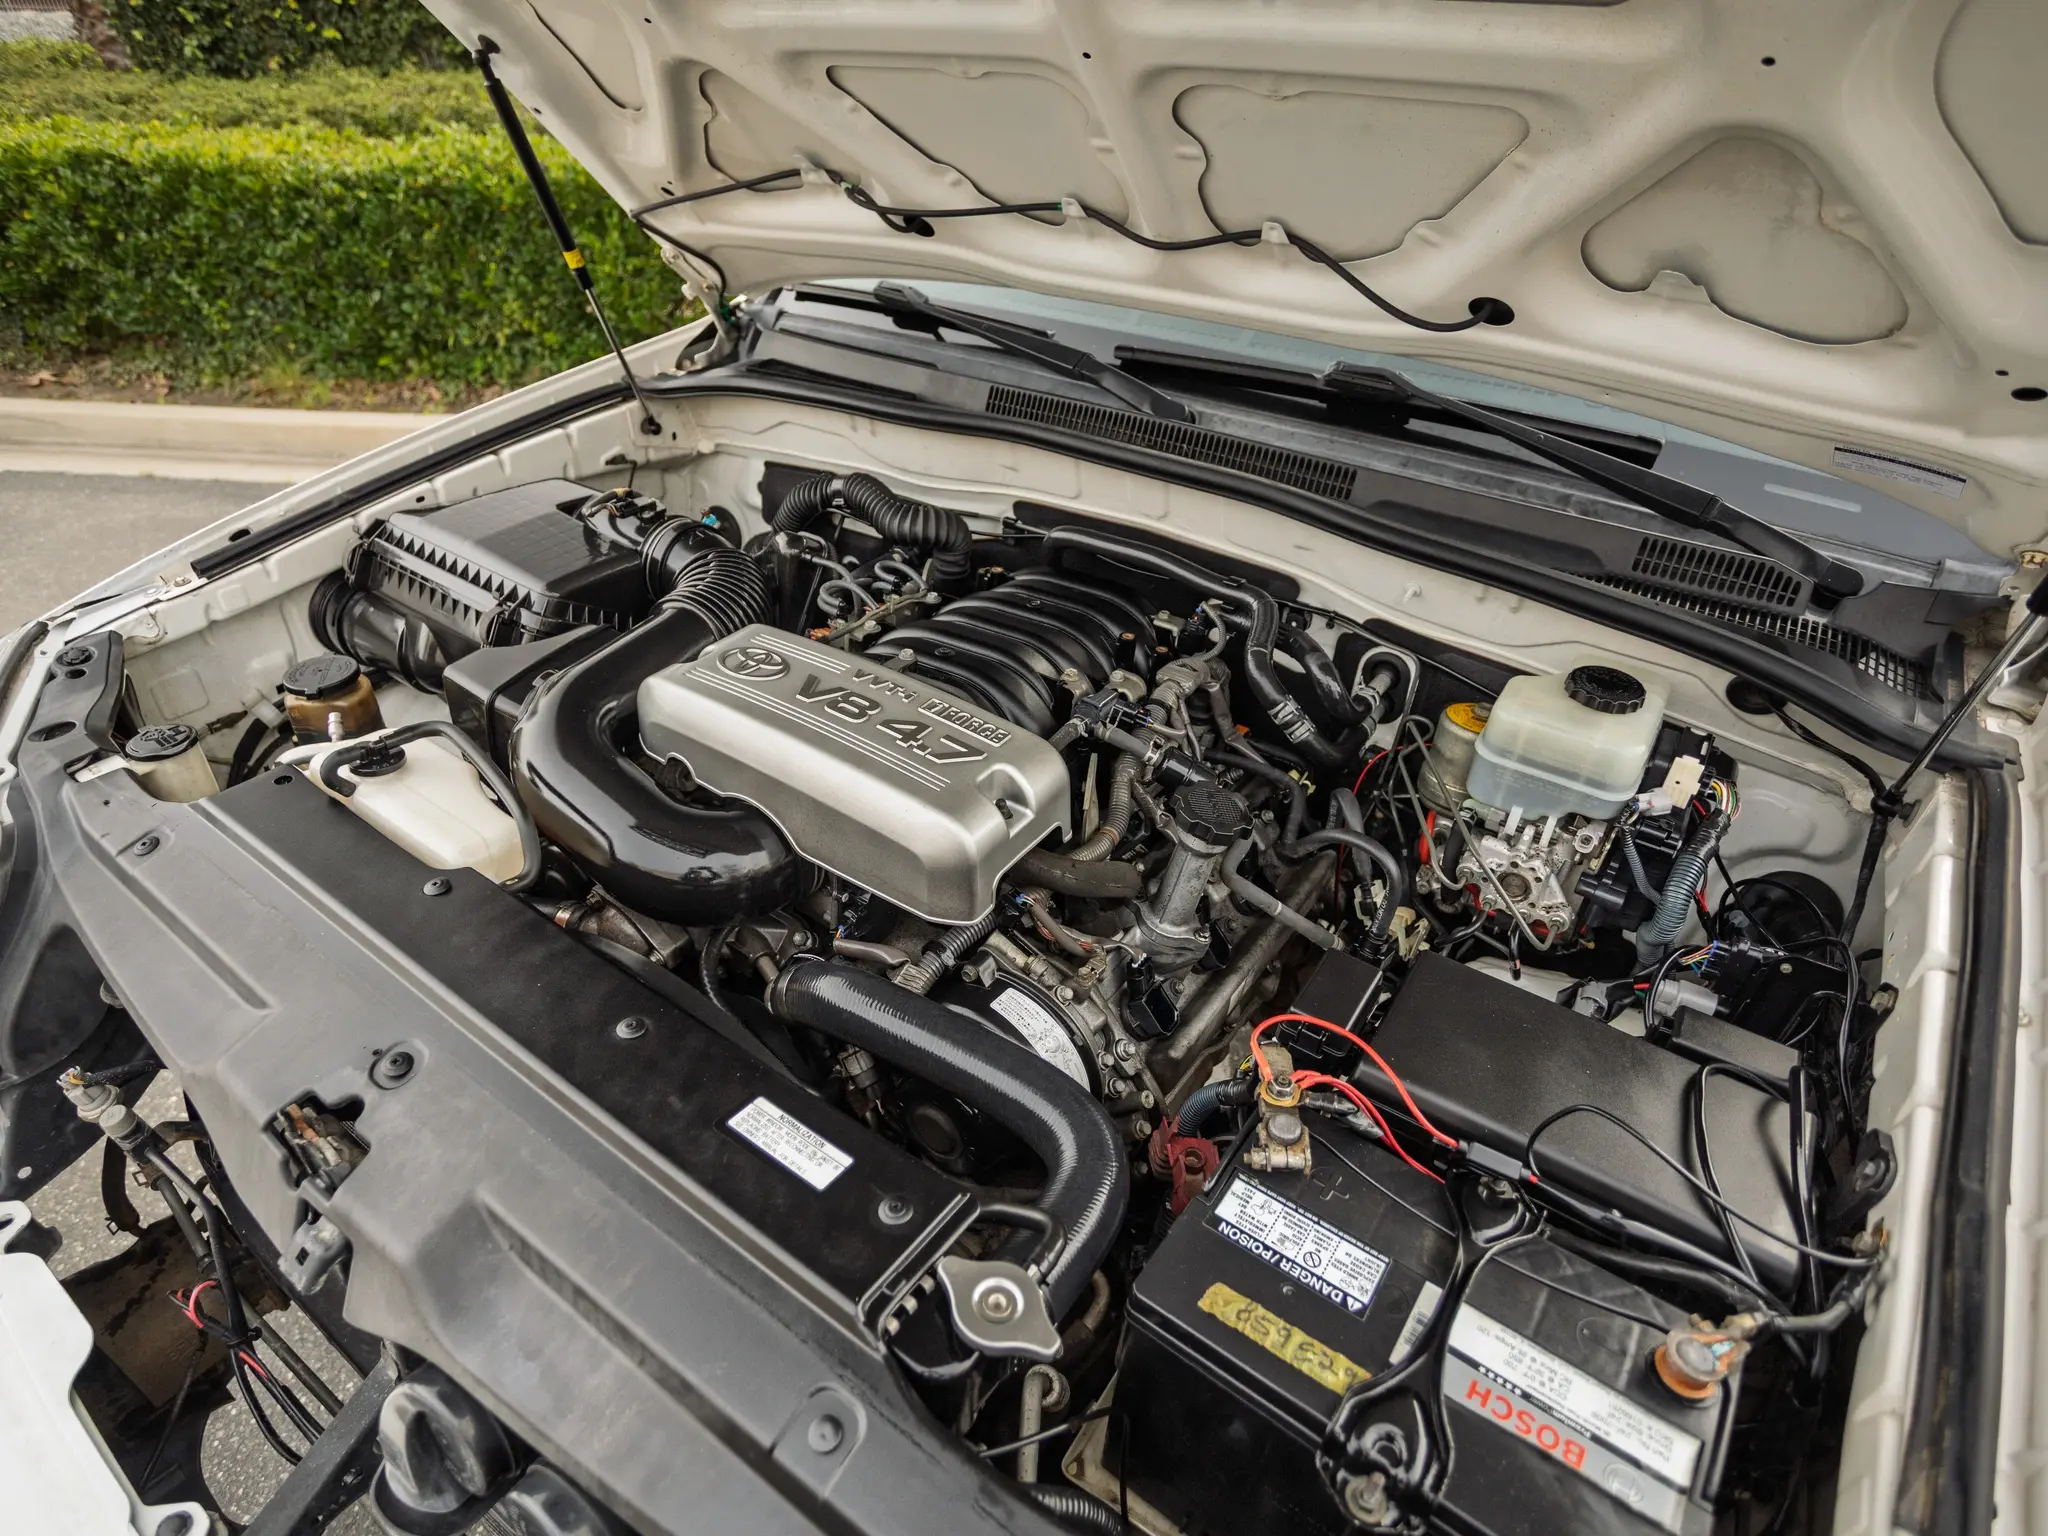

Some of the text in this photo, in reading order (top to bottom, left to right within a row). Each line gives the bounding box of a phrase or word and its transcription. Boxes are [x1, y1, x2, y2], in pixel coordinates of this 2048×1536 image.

[853, 669, 918, 703] VVT-i
[796, 674, 987, 763] V8 4.7
[777, 1114, 826, 1148] NORMALIZATION
[1229, 1190, 1249, 1204] MEDICAL
[1237, 1201, 1247, 1209] GET
[1234, 1212, 1265, 1233] IMMEDIATELY
[1239, 1208, 1268, 1228] WITH WATER
[1277, 1256, 1344, 1303] DANGER
[1463, 1375, 1587, 1472] BOSCH
